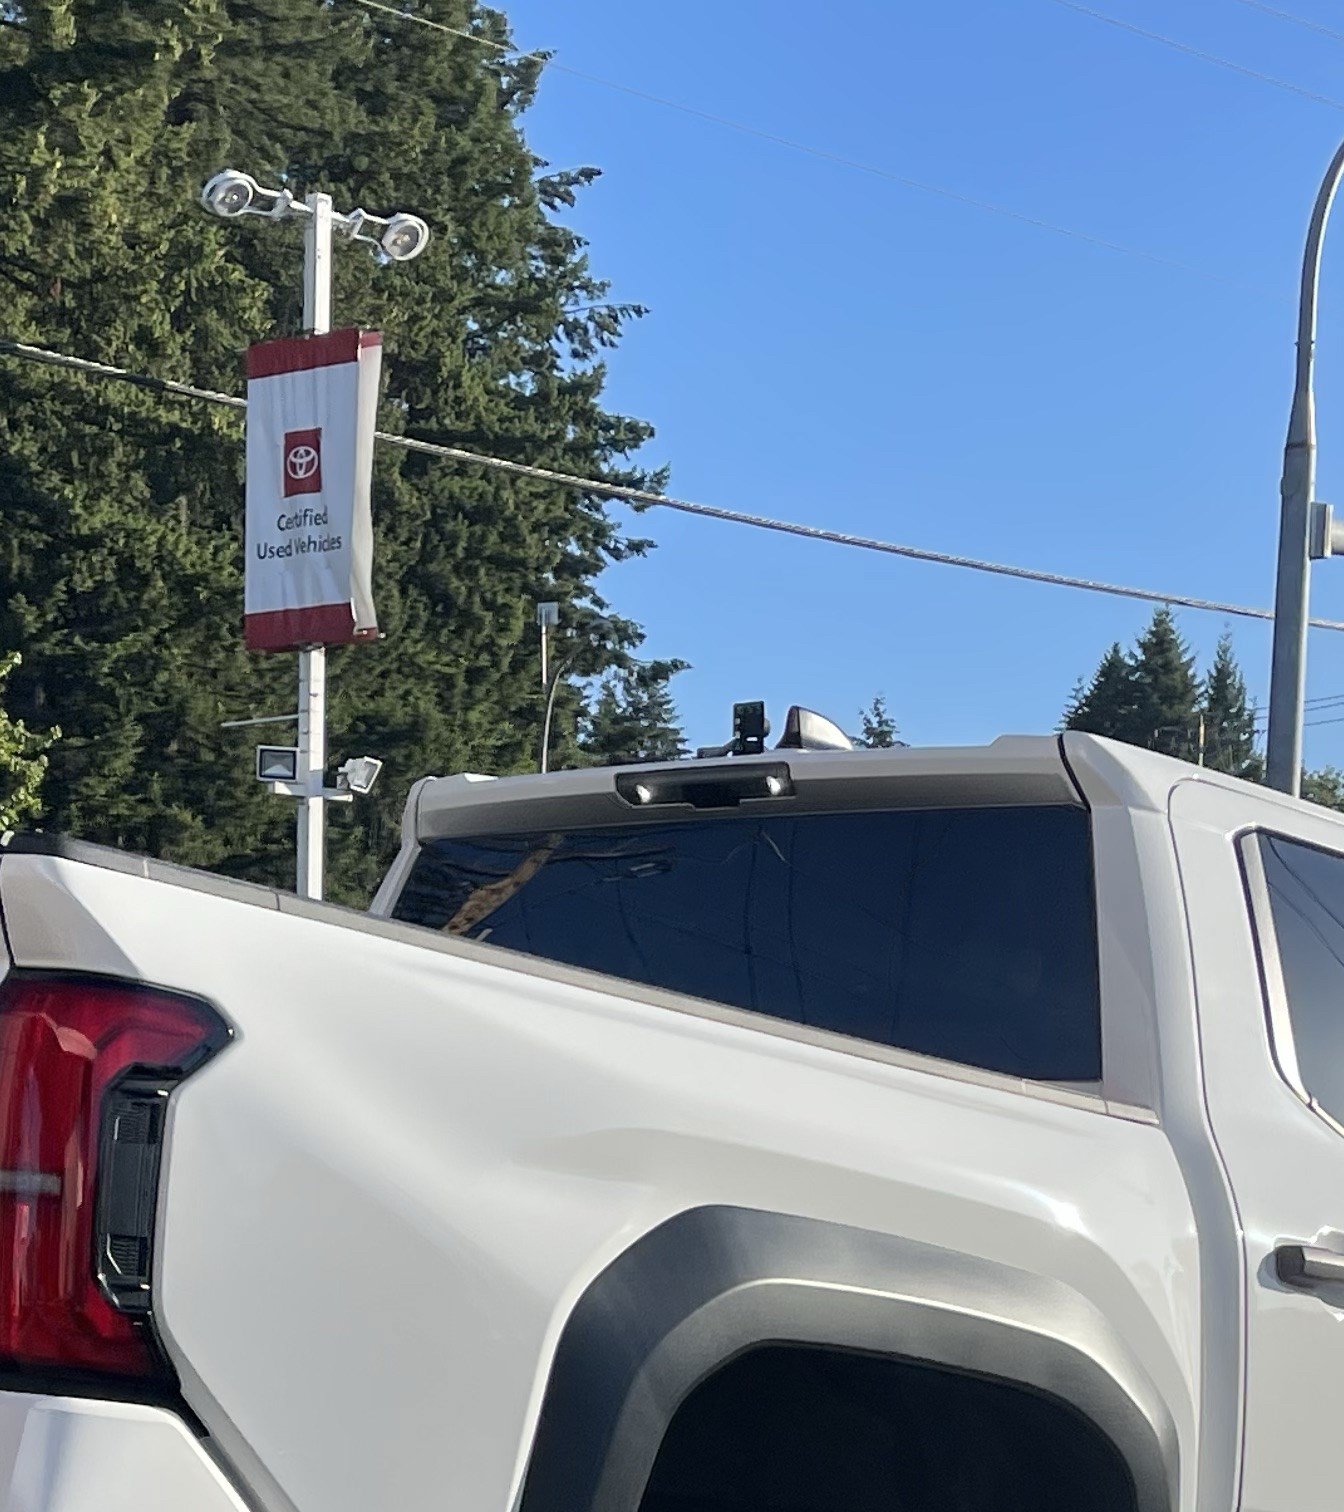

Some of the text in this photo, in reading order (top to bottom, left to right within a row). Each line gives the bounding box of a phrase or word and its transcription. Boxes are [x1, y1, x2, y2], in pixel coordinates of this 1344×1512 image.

[277, 504, 329, 531] Certified
[257, 533, 342, 560] Used Vehicles
